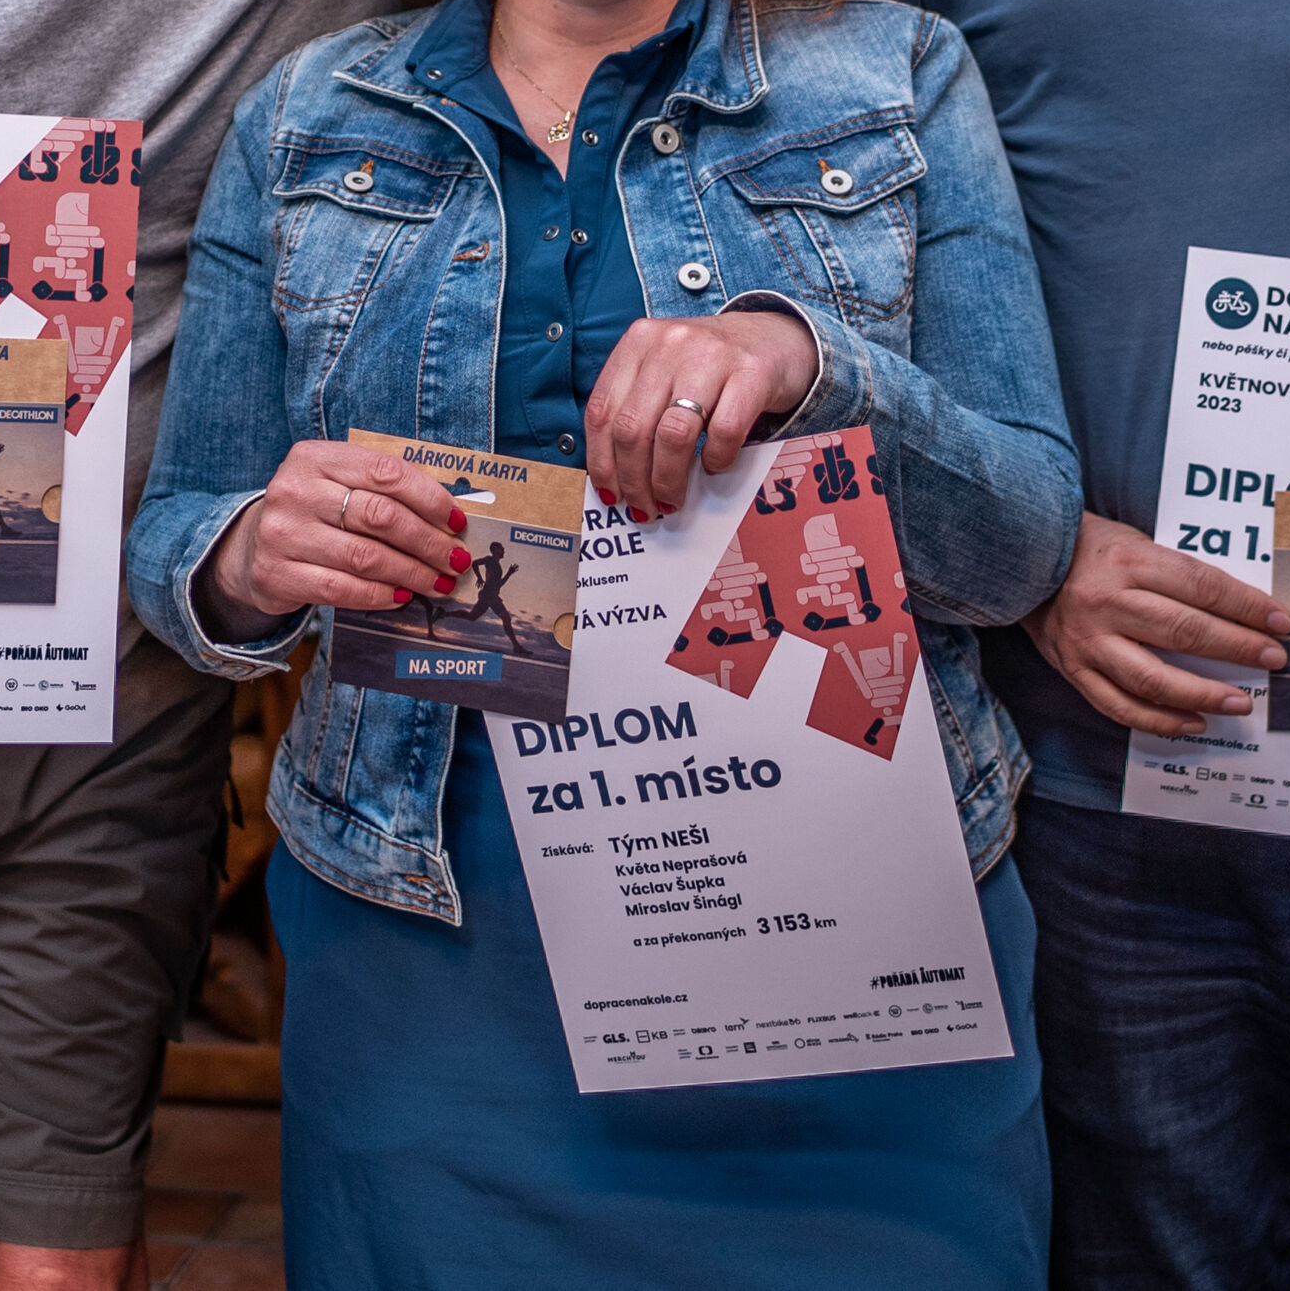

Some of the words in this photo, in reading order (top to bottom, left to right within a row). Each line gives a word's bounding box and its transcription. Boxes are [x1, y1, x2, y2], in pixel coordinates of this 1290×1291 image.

[1202, 340, 1233, 352] nebo
[1235, 343, 1273, 359] pěšky
[1275, 347, 1287, 359] či
[1196, 394, 1242, 413] 2023
[403, 445, 475, 473] DÁRKOVÁ
[478, 460, 528, 483] KARTA
[514, 530, 570, 549] DECATHLON
[1177, 523, 1231, 557] za
[1245, 525, 1271, 562] 1.
[576, 573, 629, 588] oklusem
[597, 604, 667, 626] VÝZVA
[408, 659, 431, 674] NA
[435, 660, 487, 675] SPORT
[512, 701, 698, 757] DIPLOM
[527, 781, 584, 814] za
[589, 770, 626, 807] 1.
[635, 755, 782, 803] místo
[1211, 771, 1227, 781] KB
[541, 842, 595, 858] Získává:
[608, 833, 659, 858] Tým
[661, 824, 710, 848] NEŠI
[615, 862, 661, 877] Květa
[662, 851, 747, 875] Neprašová
[620, 880, 673, 896] Václav
[676, 876, 725, 893] Šupka
[625, 899, 690, 916] Miroslav
[693, 893, 743, 910] Šinágl
[633, 938, 642, 947] a
[644, 936, 659, 946] za
[660, 927, 746, 947] překonaných
[756, 917, 771, 934] 3
[773, 913, 811, 933] 153
[814, 917, 837, 929] km
[584, 994, 688, 1011] dopracenakole.cz
[603, 1033, 630, 1044] GLS.
[651, 1031, 668, 1040] KB
